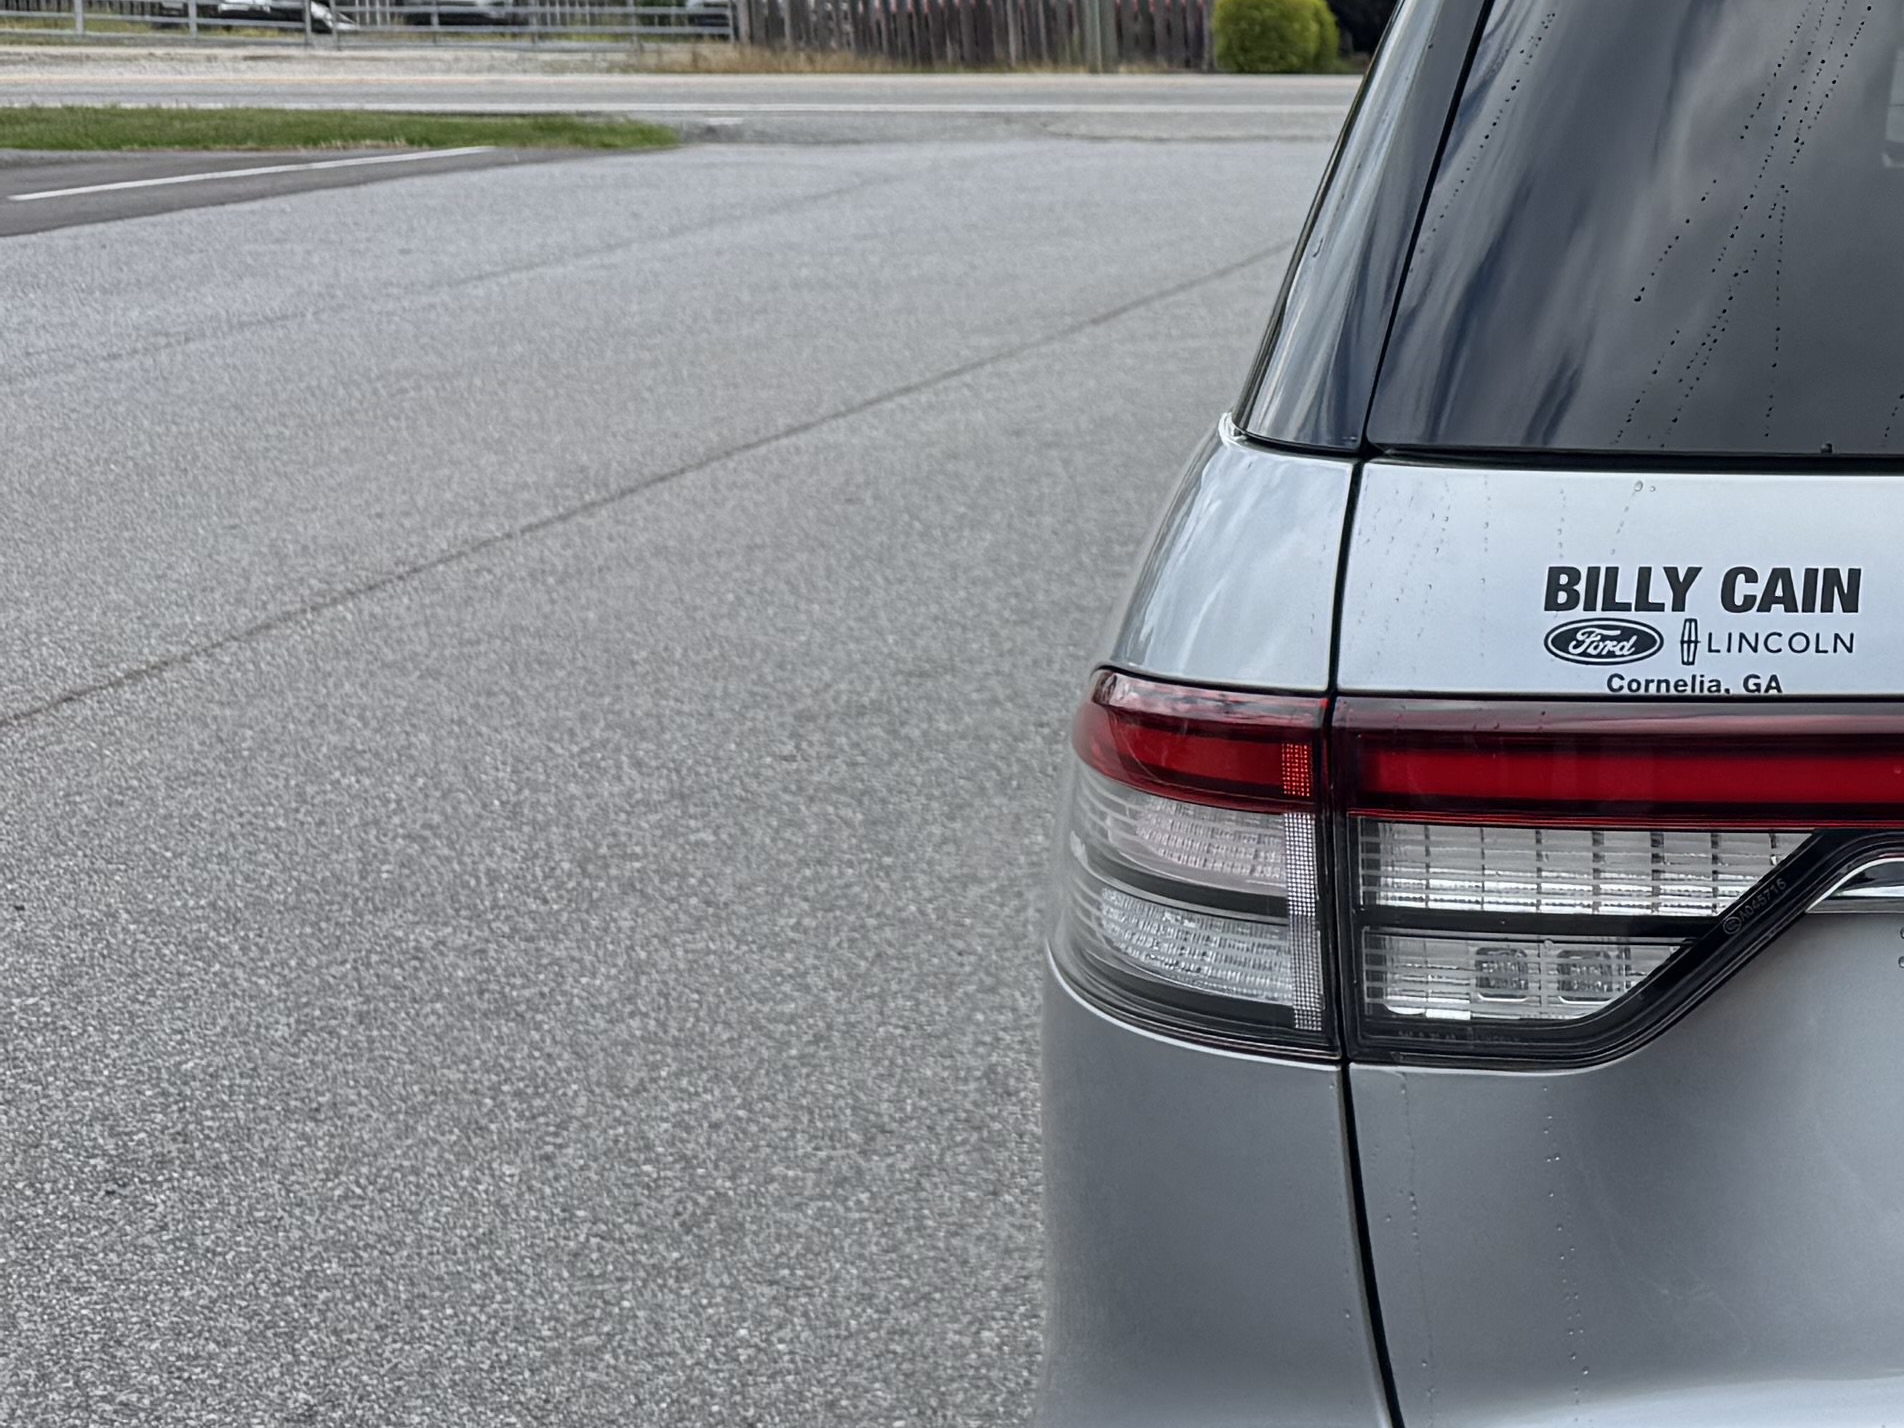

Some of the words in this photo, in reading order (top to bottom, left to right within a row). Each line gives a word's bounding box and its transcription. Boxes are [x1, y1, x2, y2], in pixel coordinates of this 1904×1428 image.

[1543, 566, 1703, 613] BILLY
[1720, 567, 1863, 614] CAIN
[1707, 631, 1855, 654] LINCOLN
[1606, 673, 1731, 695] Cornelia,
[1742, 674, 1784, 694] GA
